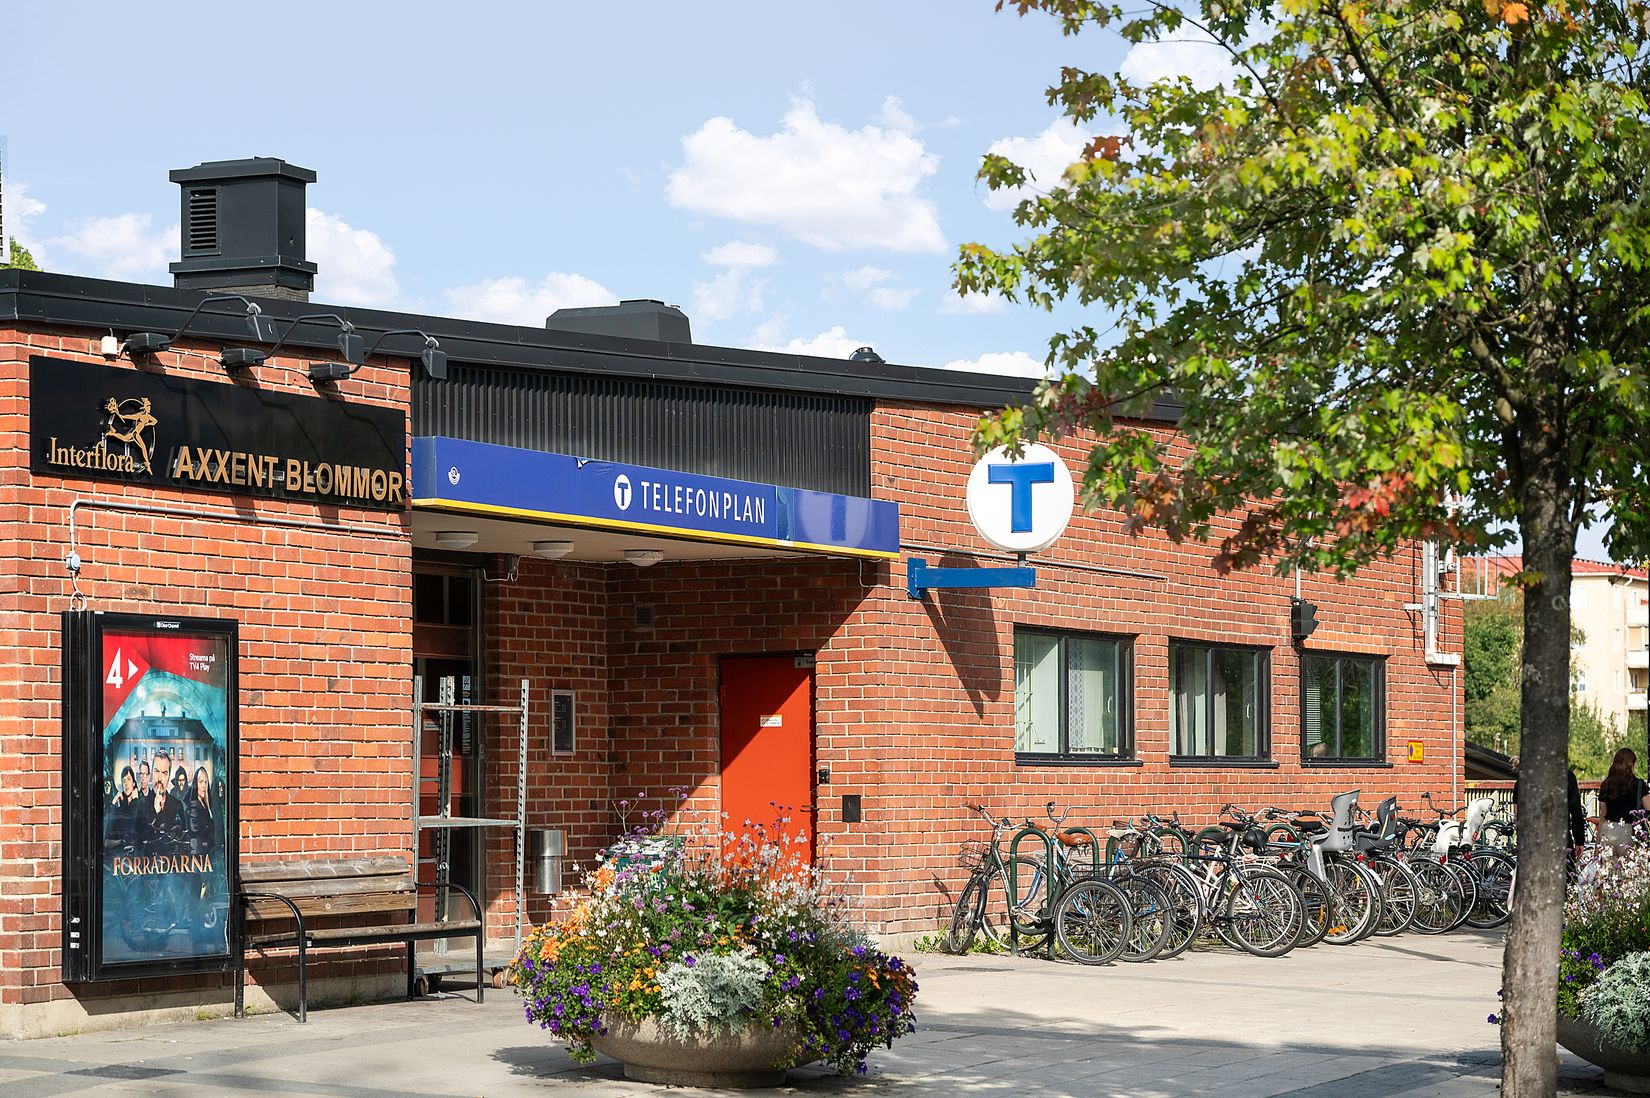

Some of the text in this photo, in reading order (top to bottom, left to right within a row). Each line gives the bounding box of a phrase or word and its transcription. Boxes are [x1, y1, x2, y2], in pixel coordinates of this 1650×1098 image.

[50, 436, 135, 474] Interflora
[174, 446, 280, 488] AXXENT
[286, 458, 403, 503] BLOMMOR
[617, 481, 765, 524] T TELEFONPLAN
[988, 462, 1053, 533] T
[105, 647, 123, 689] 4
[189, 653, 208, 662] Streama
[189, 662, 210, 673] TV4 Play
